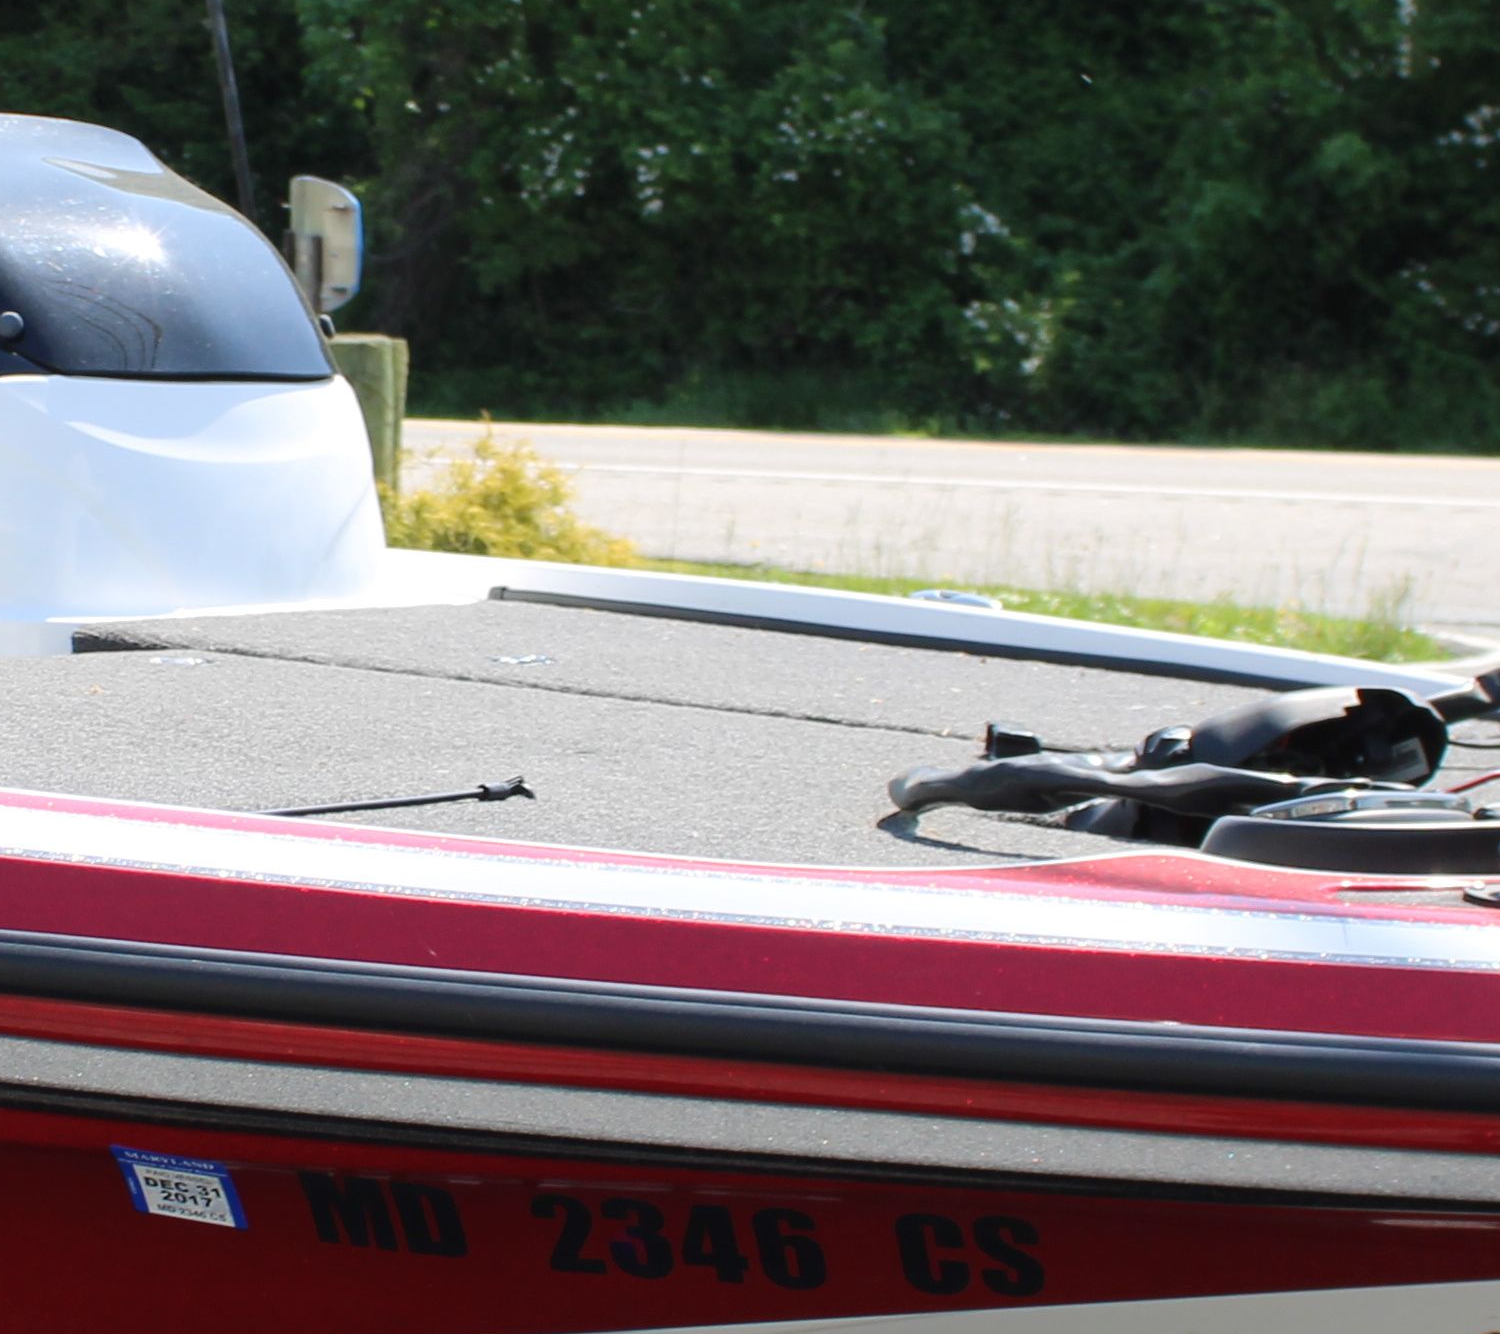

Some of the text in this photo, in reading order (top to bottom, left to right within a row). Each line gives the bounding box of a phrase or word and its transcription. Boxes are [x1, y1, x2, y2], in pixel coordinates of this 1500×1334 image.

[124, 1151, 215, 1170] MARYLAND
[144, 1176, 189, 1193] DEC
[196, 1185, 222, 1199] 31
[160, 1189, 213, 1208] 2017
[297, 1170, 1045, 1298] MD 2346 CS
